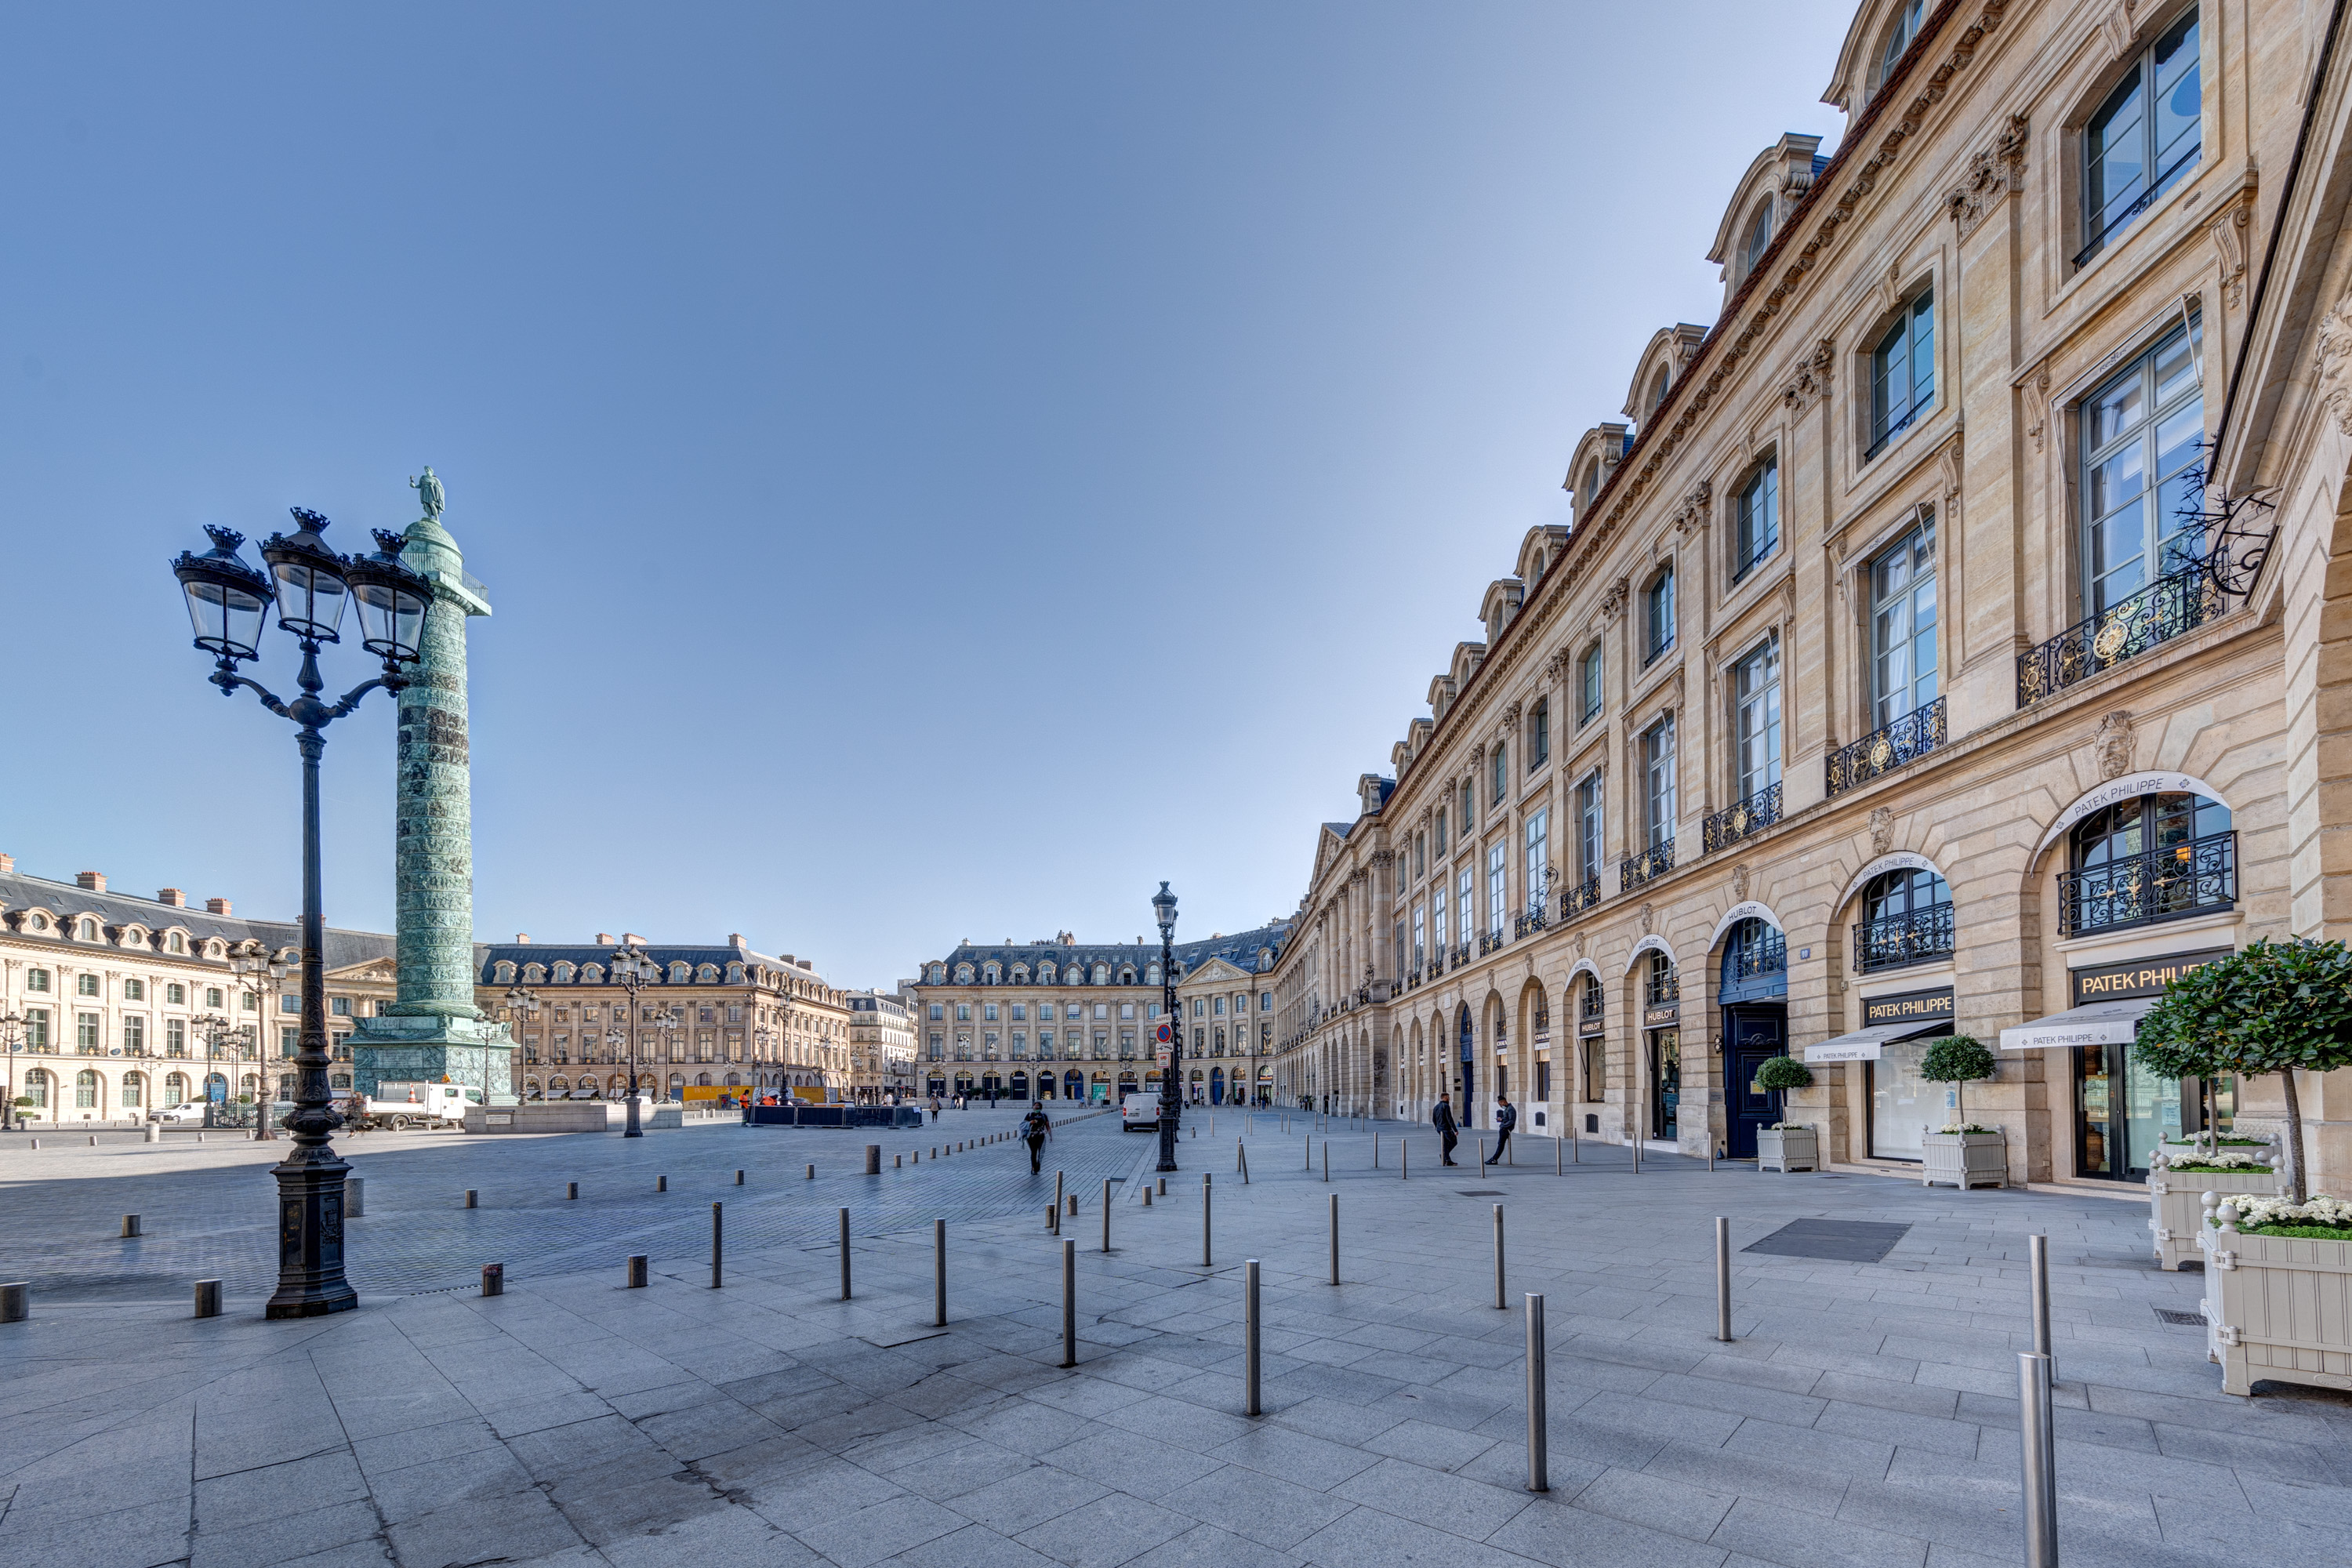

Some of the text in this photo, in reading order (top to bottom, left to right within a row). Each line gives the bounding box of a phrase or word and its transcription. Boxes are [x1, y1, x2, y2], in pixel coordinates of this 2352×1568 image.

[2074, 778, 2164, 816] PATEK PHILIPPE
[1863, 857, 1915, 879] PATEK PHILIPPE
[1728, 906, 1757, 922] HUBLOT
[1639, 938, 1659, 951] HUBLOT
[1802, 949, 1808, 958] 10
[2082, 972, 2136, 994] PATEK
[1869, 996, 1952, 1018] PATEK PHILIPPE
[1648, 1009, 1673, 1022] HUBLOT
[1581, 1022, 1601, 1032] HUBLOT
[2033, 1033, 2093, 1045] PATEK PHILIPPE
